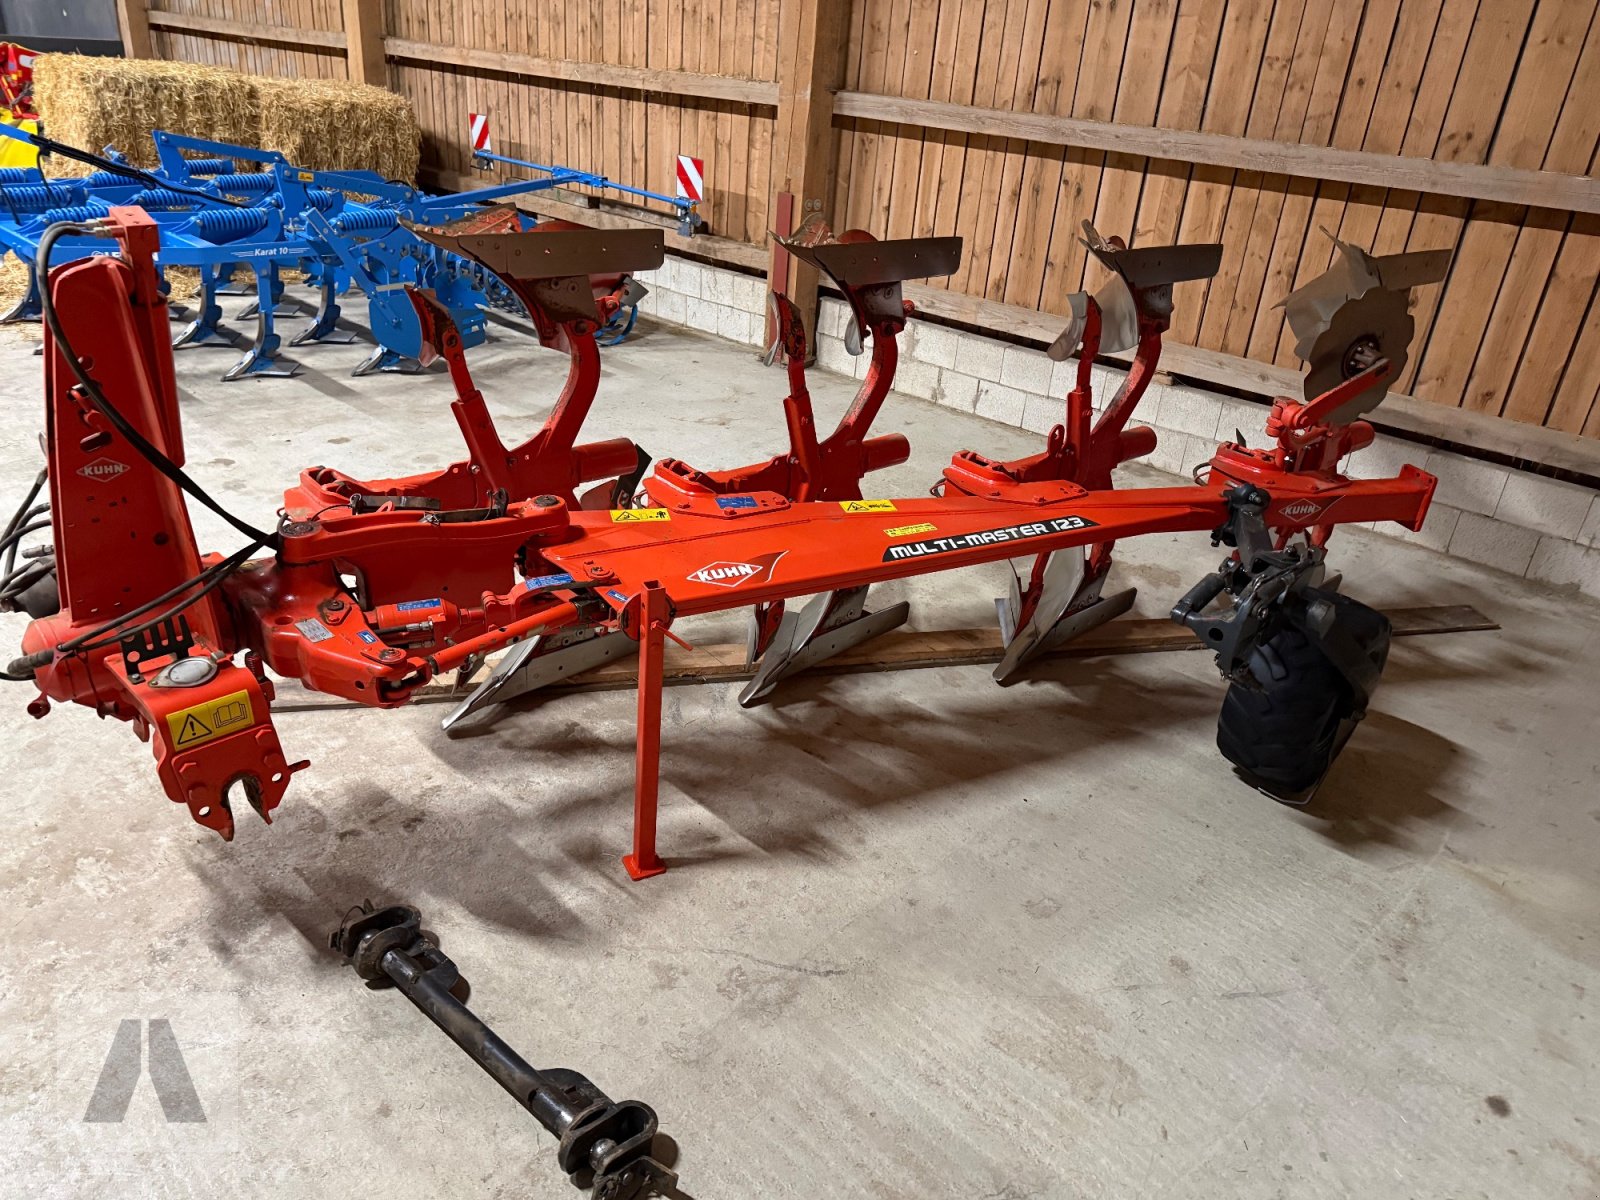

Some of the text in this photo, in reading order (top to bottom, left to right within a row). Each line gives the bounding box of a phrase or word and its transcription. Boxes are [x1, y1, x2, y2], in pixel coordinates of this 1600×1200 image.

[254, 246, 289, 257] Karat 10
[83, 464, 123, 476] KUHN
[1285, 504, 1316, 515] KUHN
[889, 523, 1050, 559] MULTI-MASTER
[1050, 517, 1085, 531] 123
[696, 563, 753, 581] KUHN
